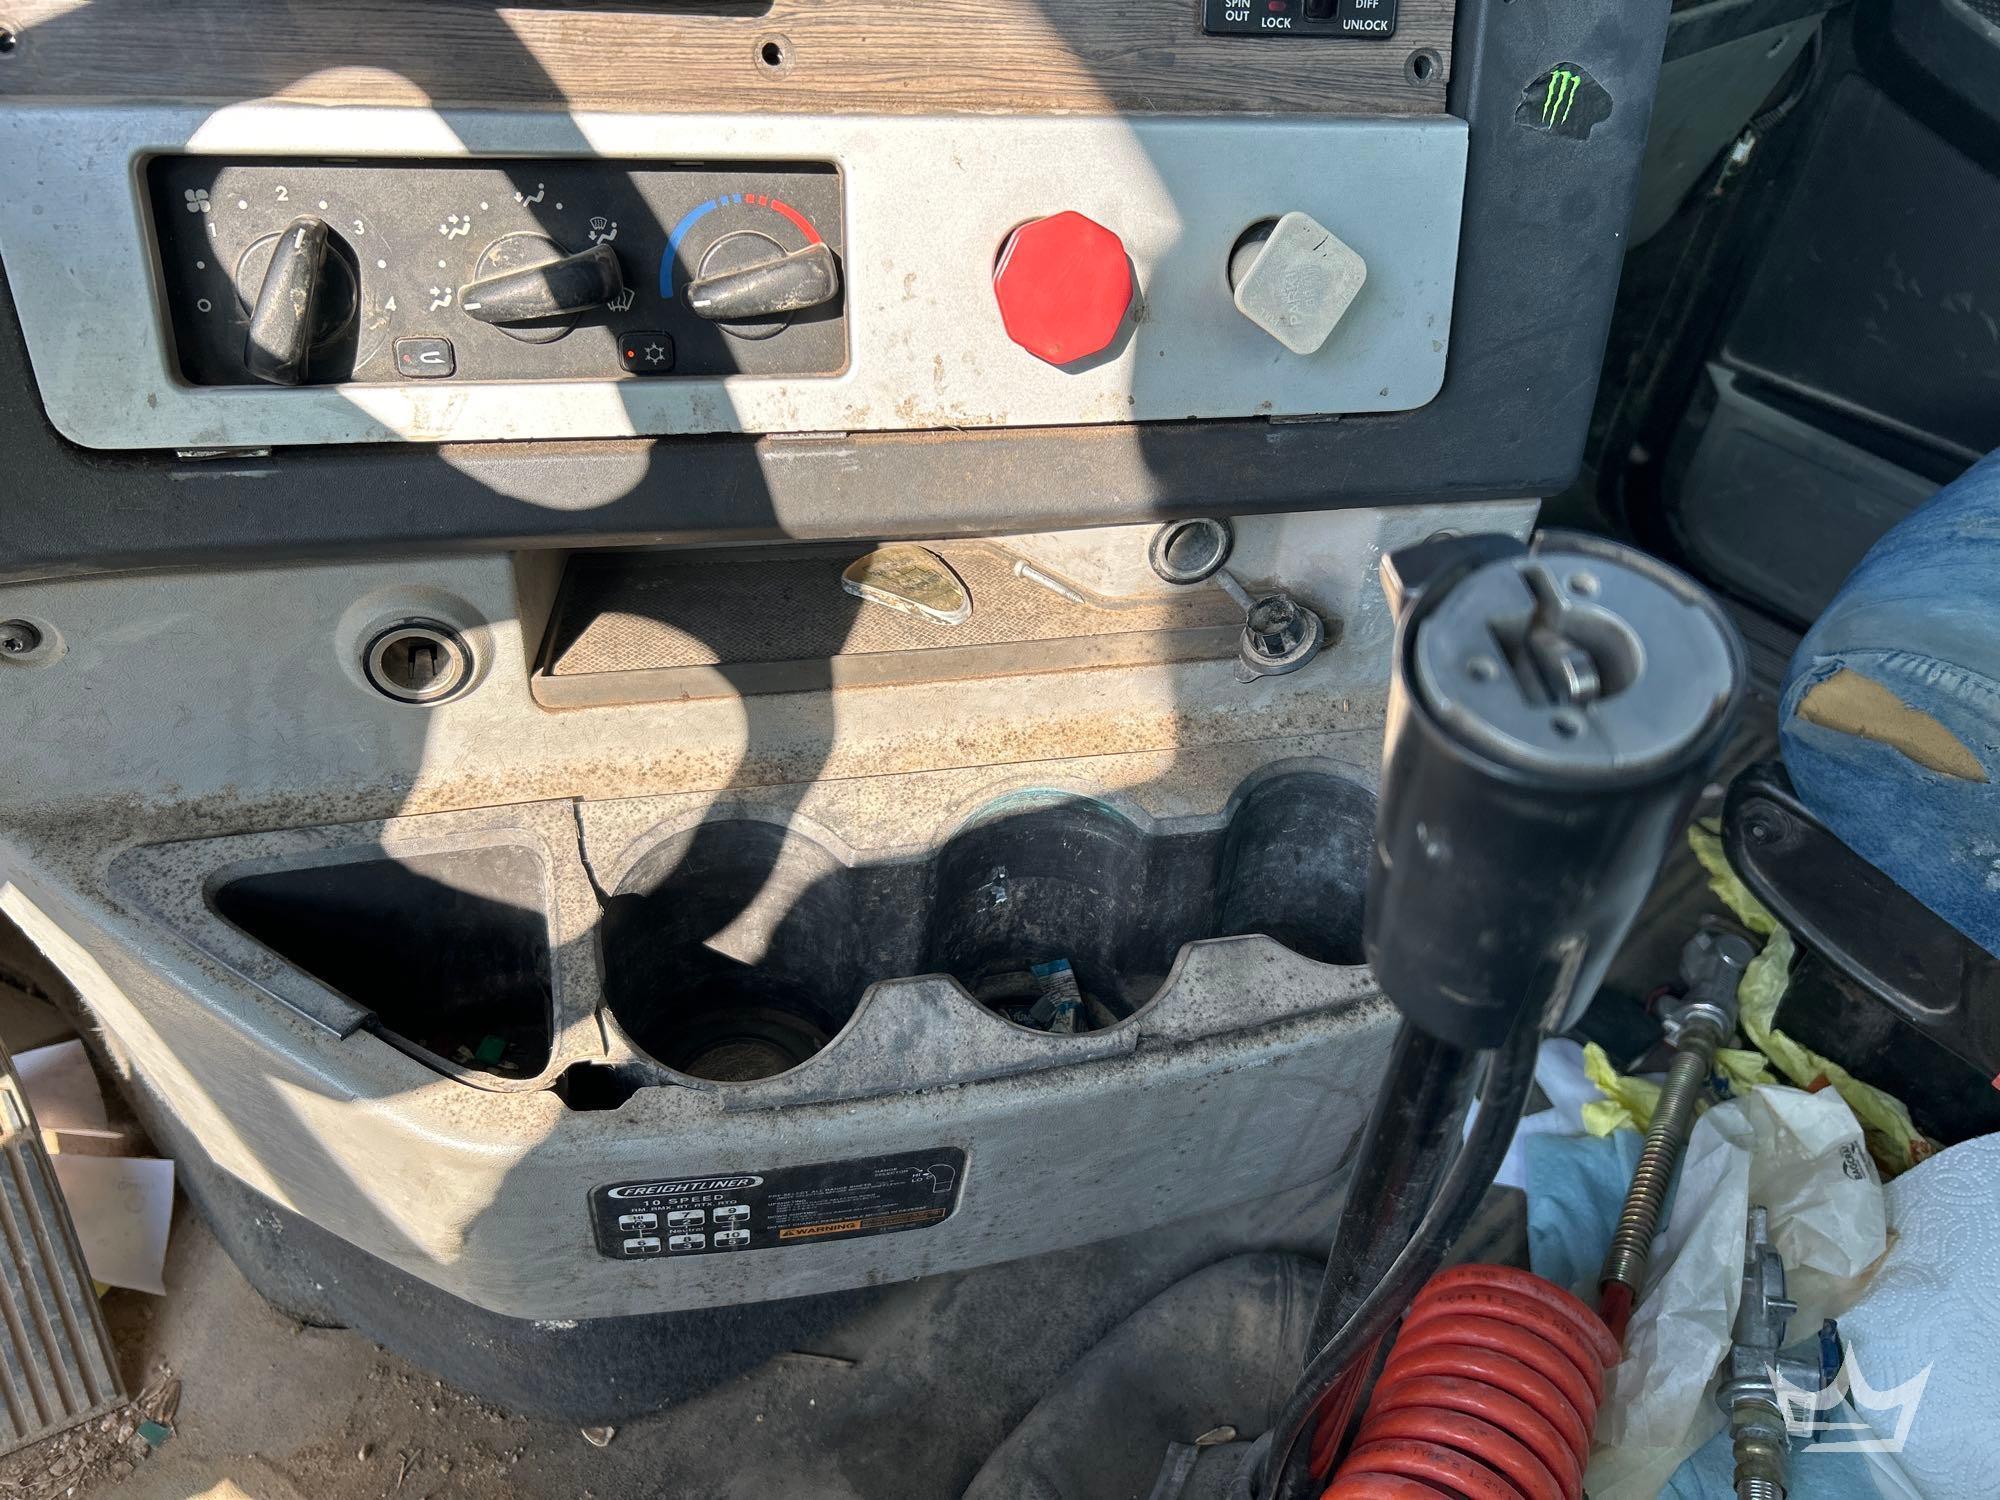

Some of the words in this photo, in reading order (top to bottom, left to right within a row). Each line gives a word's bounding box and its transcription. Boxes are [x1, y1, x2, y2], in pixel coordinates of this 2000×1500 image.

[1225, 0, 1250, 8] SPIN
[1355, 0, 1379, 9] DIFF
[1225, 10, 1250, 21] OUT
[1261, 17, 1291, 29] LOCK
[1342, 19, 1388, 31] UNLOCK
[275, 185, 289, 201] 2
[208, 222, 217, 238] 1
[353, 219, 365, 236] 3
[385, 295, 397, 312] 4
[624, 1178, 749, 1196] FREIGHTLINER
[668, 1194, 724, 1205] SPEED
[795, 1223, 856, 1235] WARNING
